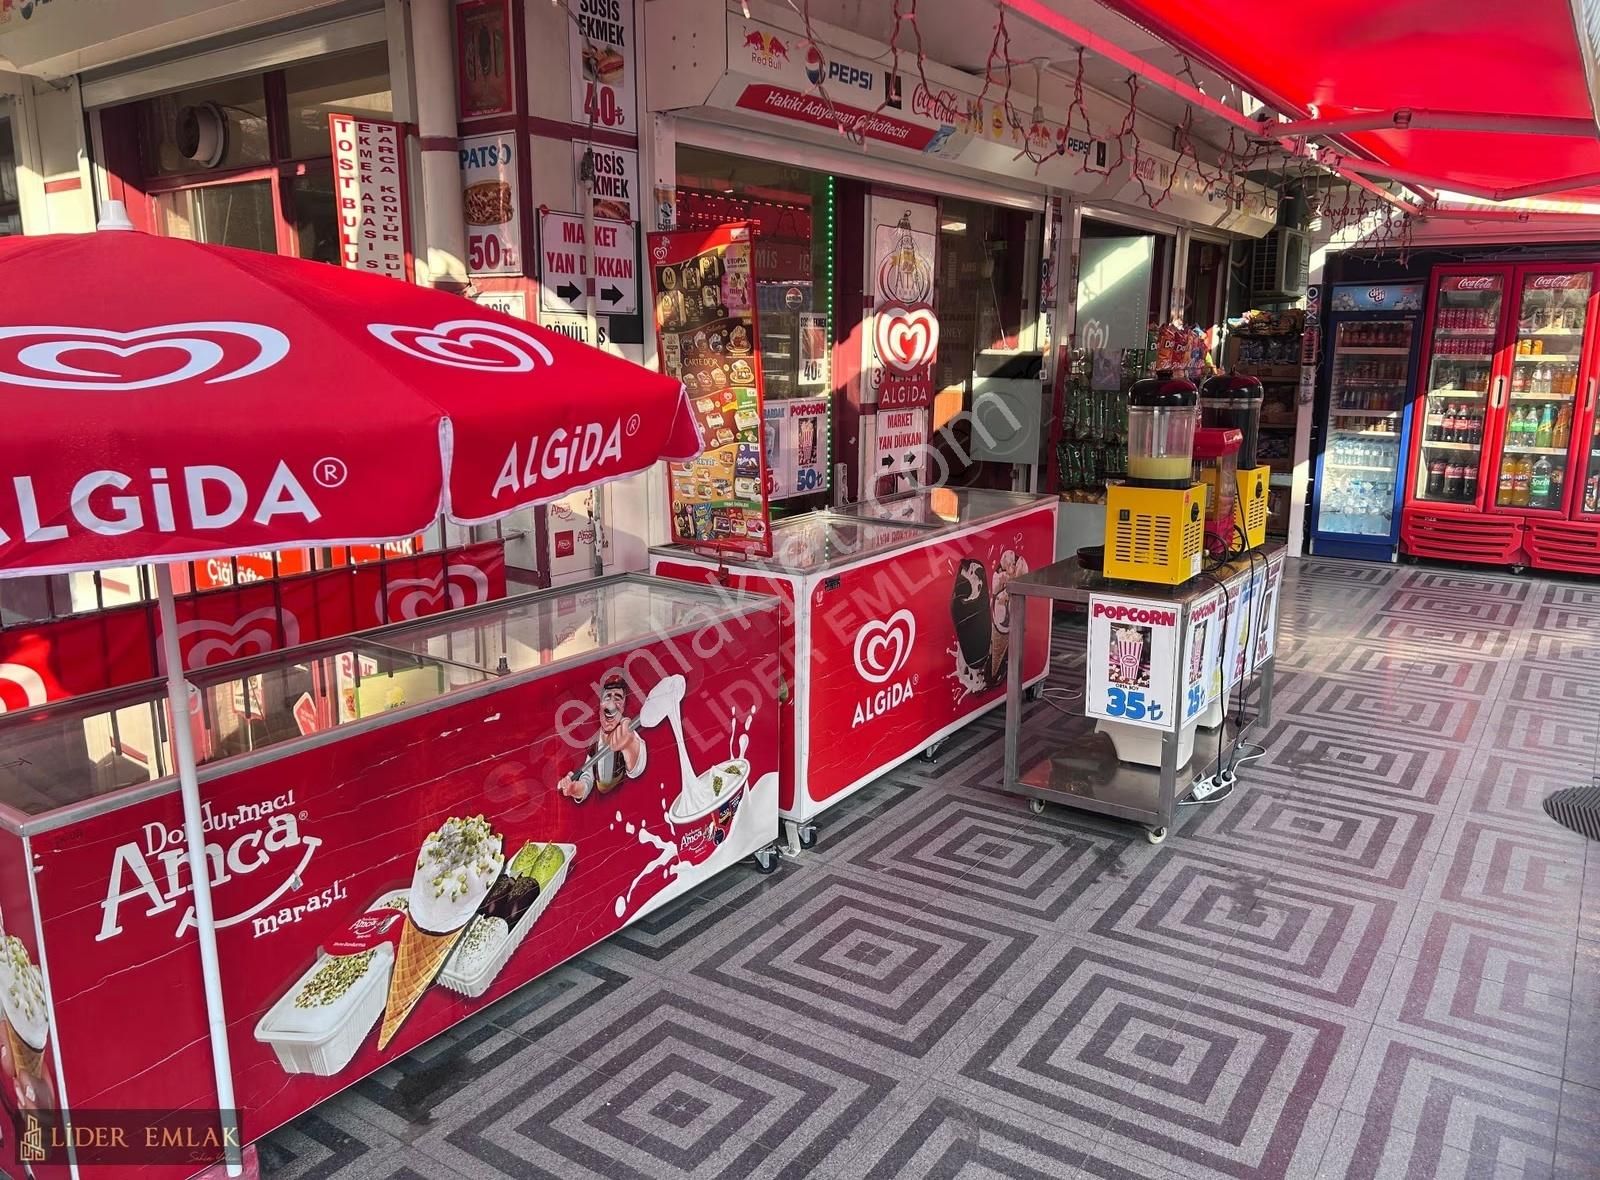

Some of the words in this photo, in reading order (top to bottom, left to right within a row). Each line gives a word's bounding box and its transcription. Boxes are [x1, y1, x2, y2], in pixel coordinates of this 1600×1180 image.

[578, 14, 625, 47] EKMEK
[828, 61, 873, 91] PEPSI
[765, 91, 802, 110] Hakiki
[336, 121, 354, 188] TOST
[461, 143, 512, 170] PATSO
[563, 222, 617, 248] MAKET
[469, 233, 500, 270] 50
[546, 251, 575, 275] YAN
[1457, 277, 1495, 290] Coca-Cola
[1533, 275, 1572, 288] Coca-Cola
[790, 403, 826, 417] POPCORN
[887, 412, 914, 429] MARKET
[879, 435, 896, 450] YAN
[1093, 603, 1176, 627] POPCORN
[252, 879, 348, 939] maraşlı
